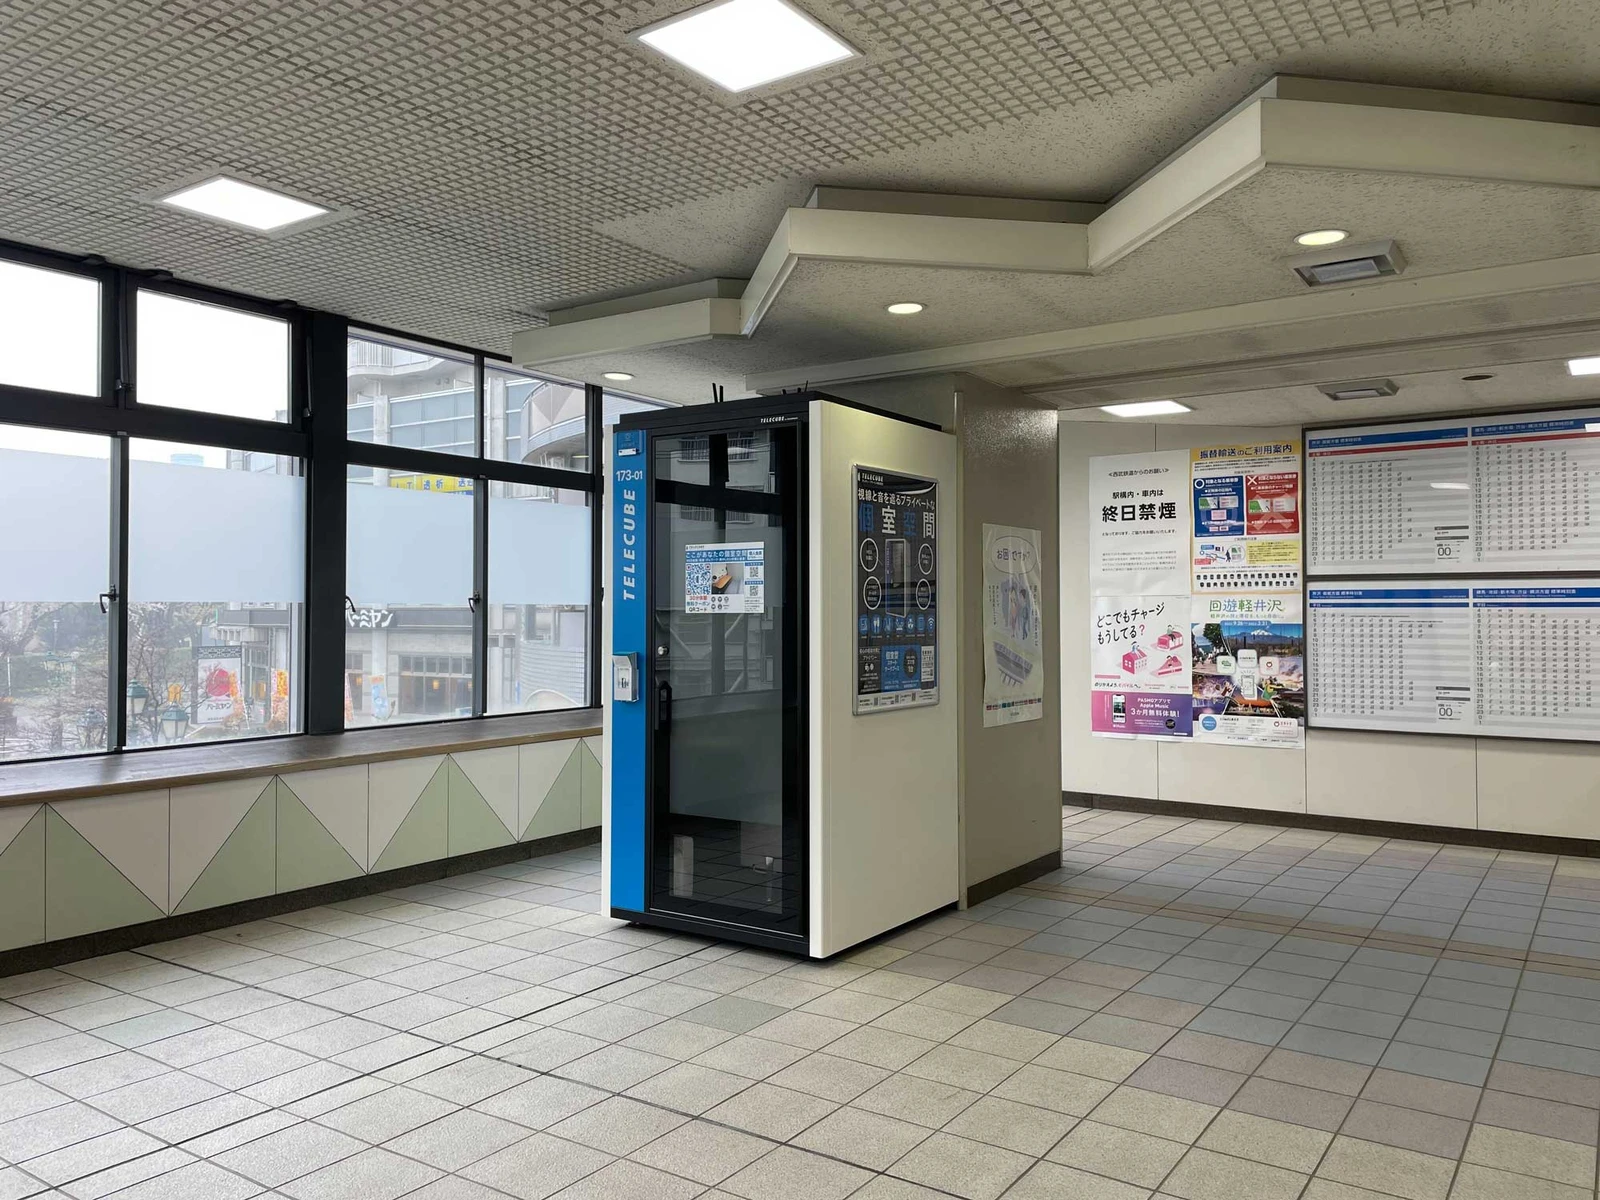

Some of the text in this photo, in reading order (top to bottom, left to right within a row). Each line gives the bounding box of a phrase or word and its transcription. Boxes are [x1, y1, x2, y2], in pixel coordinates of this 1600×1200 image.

[1200, 444, 1292, 459] 振替輸送のご利用案内
[616, 470, 643, 481] 173-01
[1112, 489, 1164, 499] 駅構内・車内は
[1102, 502, 1177, 523] 終日禁煙
[623, 489, 636, 600] TELECUBE
[1438, 547, 1452, 556] 00
[1097, 601, 1165, 628] どこでもチャージ
[1438, 707, 1452, 717] 00
